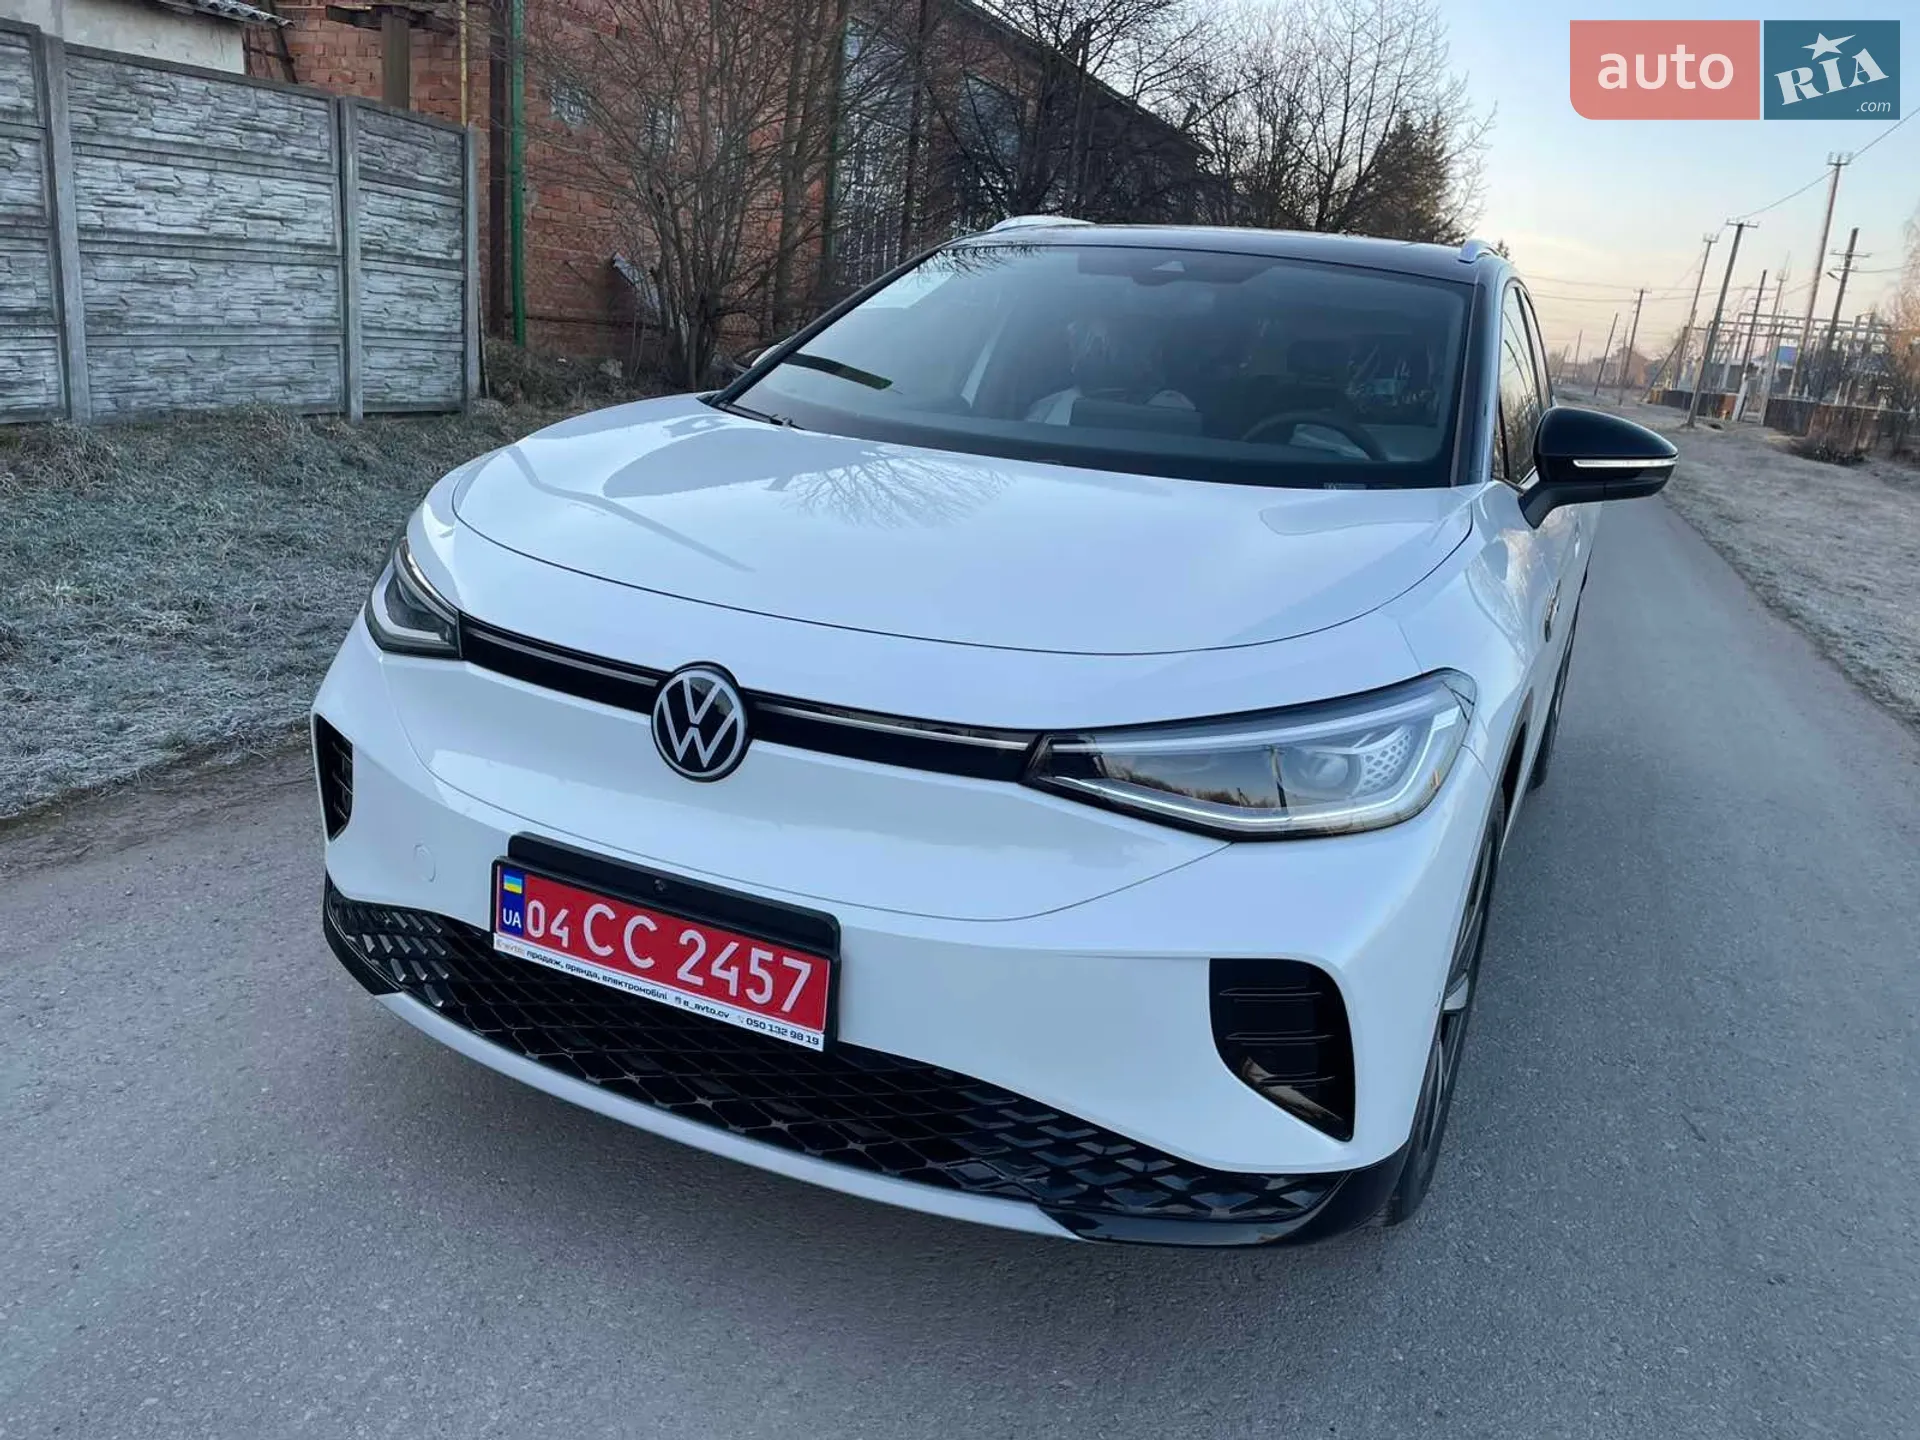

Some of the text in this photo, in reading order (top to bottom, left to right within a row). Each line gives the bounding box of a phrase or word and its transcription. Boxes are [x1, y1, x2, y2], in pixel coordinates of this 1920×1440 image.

[502, 908, 522, 928] UA
[526, 899, 812, 1013] 04 CC 2457
[746, 1017, 766, 1031] 050
[768, 1024, 788, 1037] 132
[789, 1030, 804, 1042] 98
[806, 1034, 820, 1046] 19
